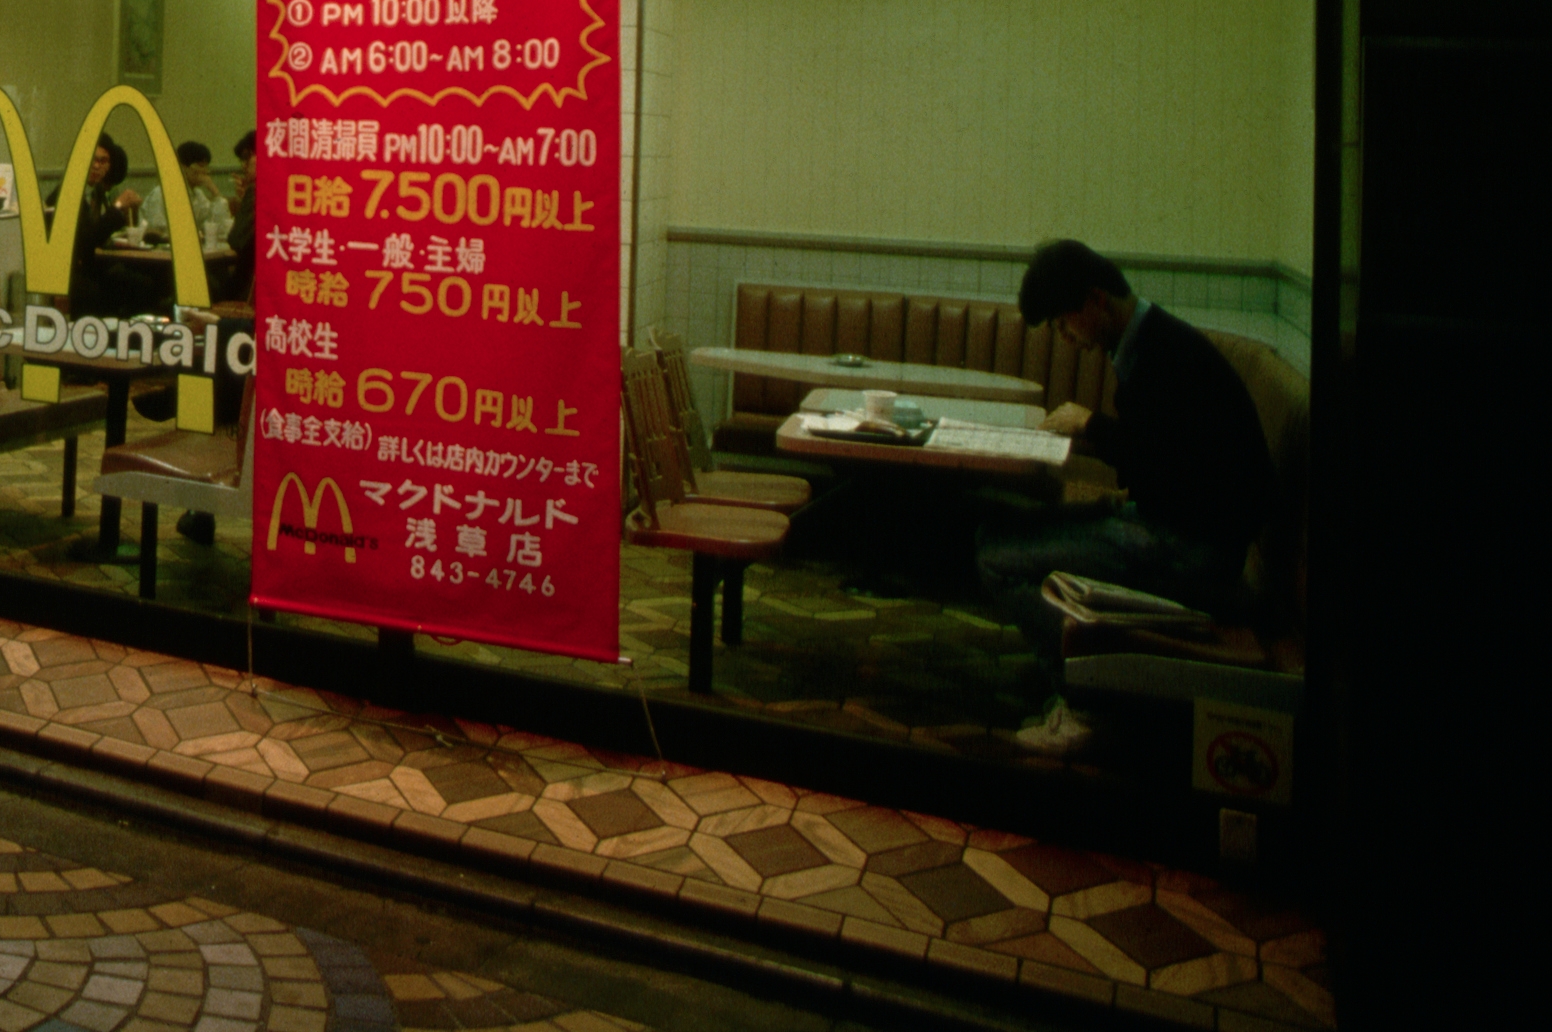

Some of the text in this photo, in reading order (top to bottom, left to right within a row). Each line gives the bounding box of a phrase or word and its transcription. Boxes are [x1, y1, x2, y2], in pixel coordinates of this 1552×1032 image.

[264, 117, 380, 162] 夜間清掃員
[358, 478, 579, 530] マクドナルド
[410, 555, 557, 597] 843-4746
